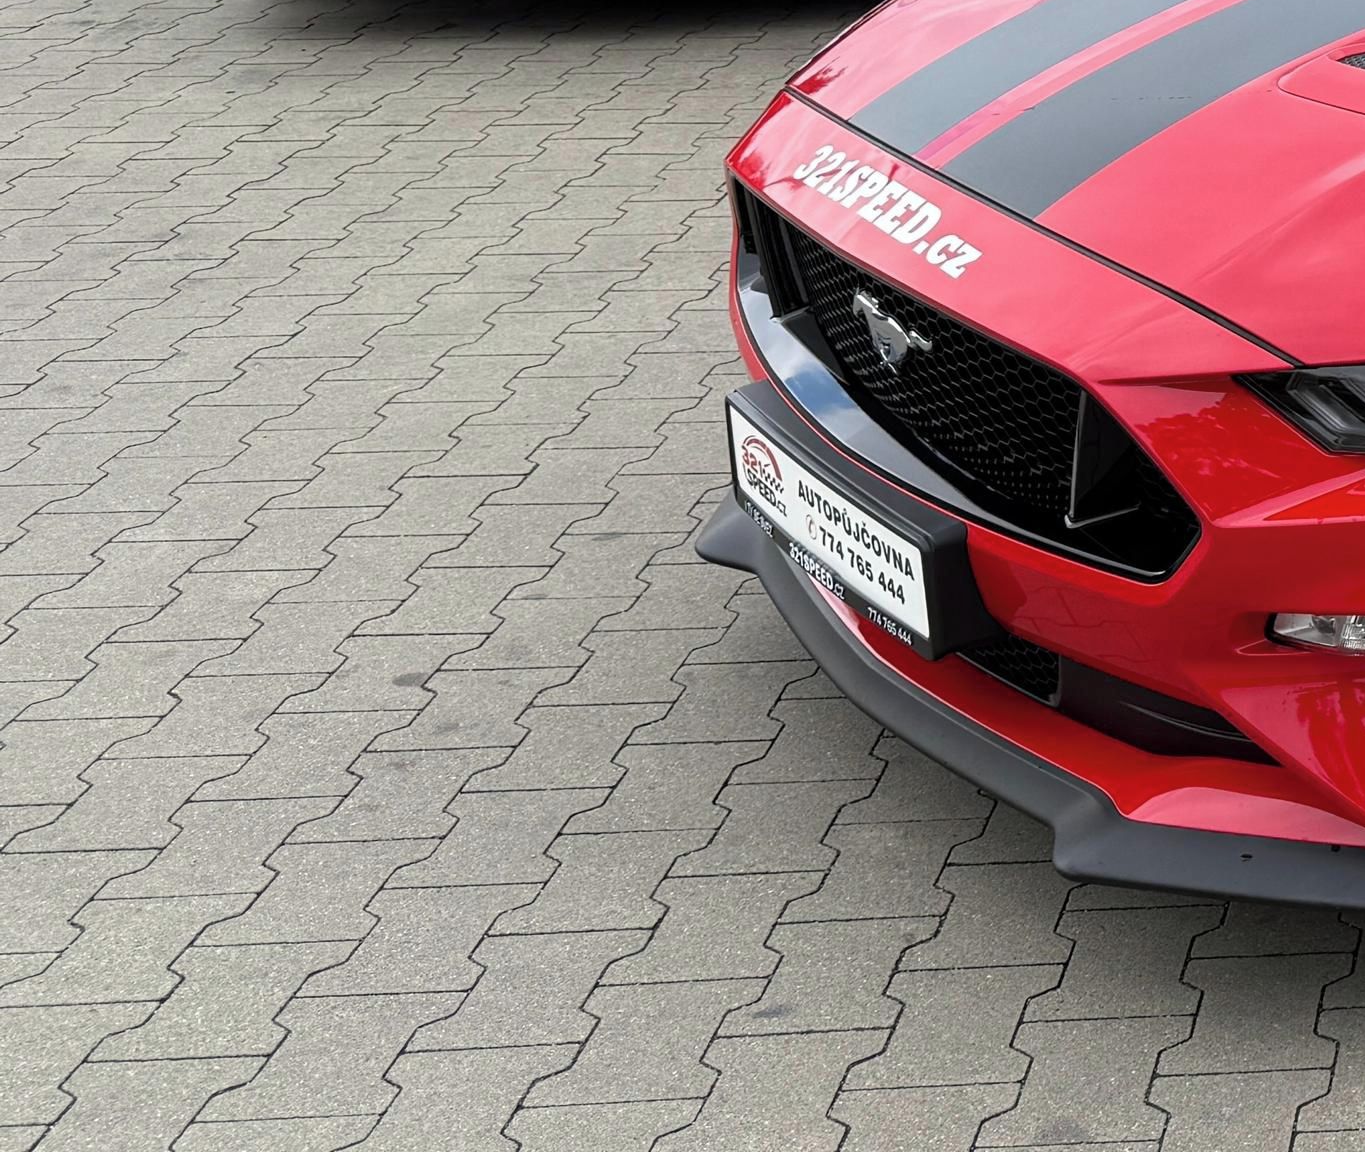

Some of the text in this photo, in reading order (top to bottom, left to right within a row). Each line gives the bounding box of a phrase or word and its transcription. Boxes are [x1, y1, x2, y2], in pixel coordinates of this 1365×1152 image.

[742, 444, 763, 479] 321
[798, 479, 916, 581] AUTOPŮJČOVNA
[819, 525, 906, 606] 774 765 444
[867, 606, 912, 646] 774 765 444
